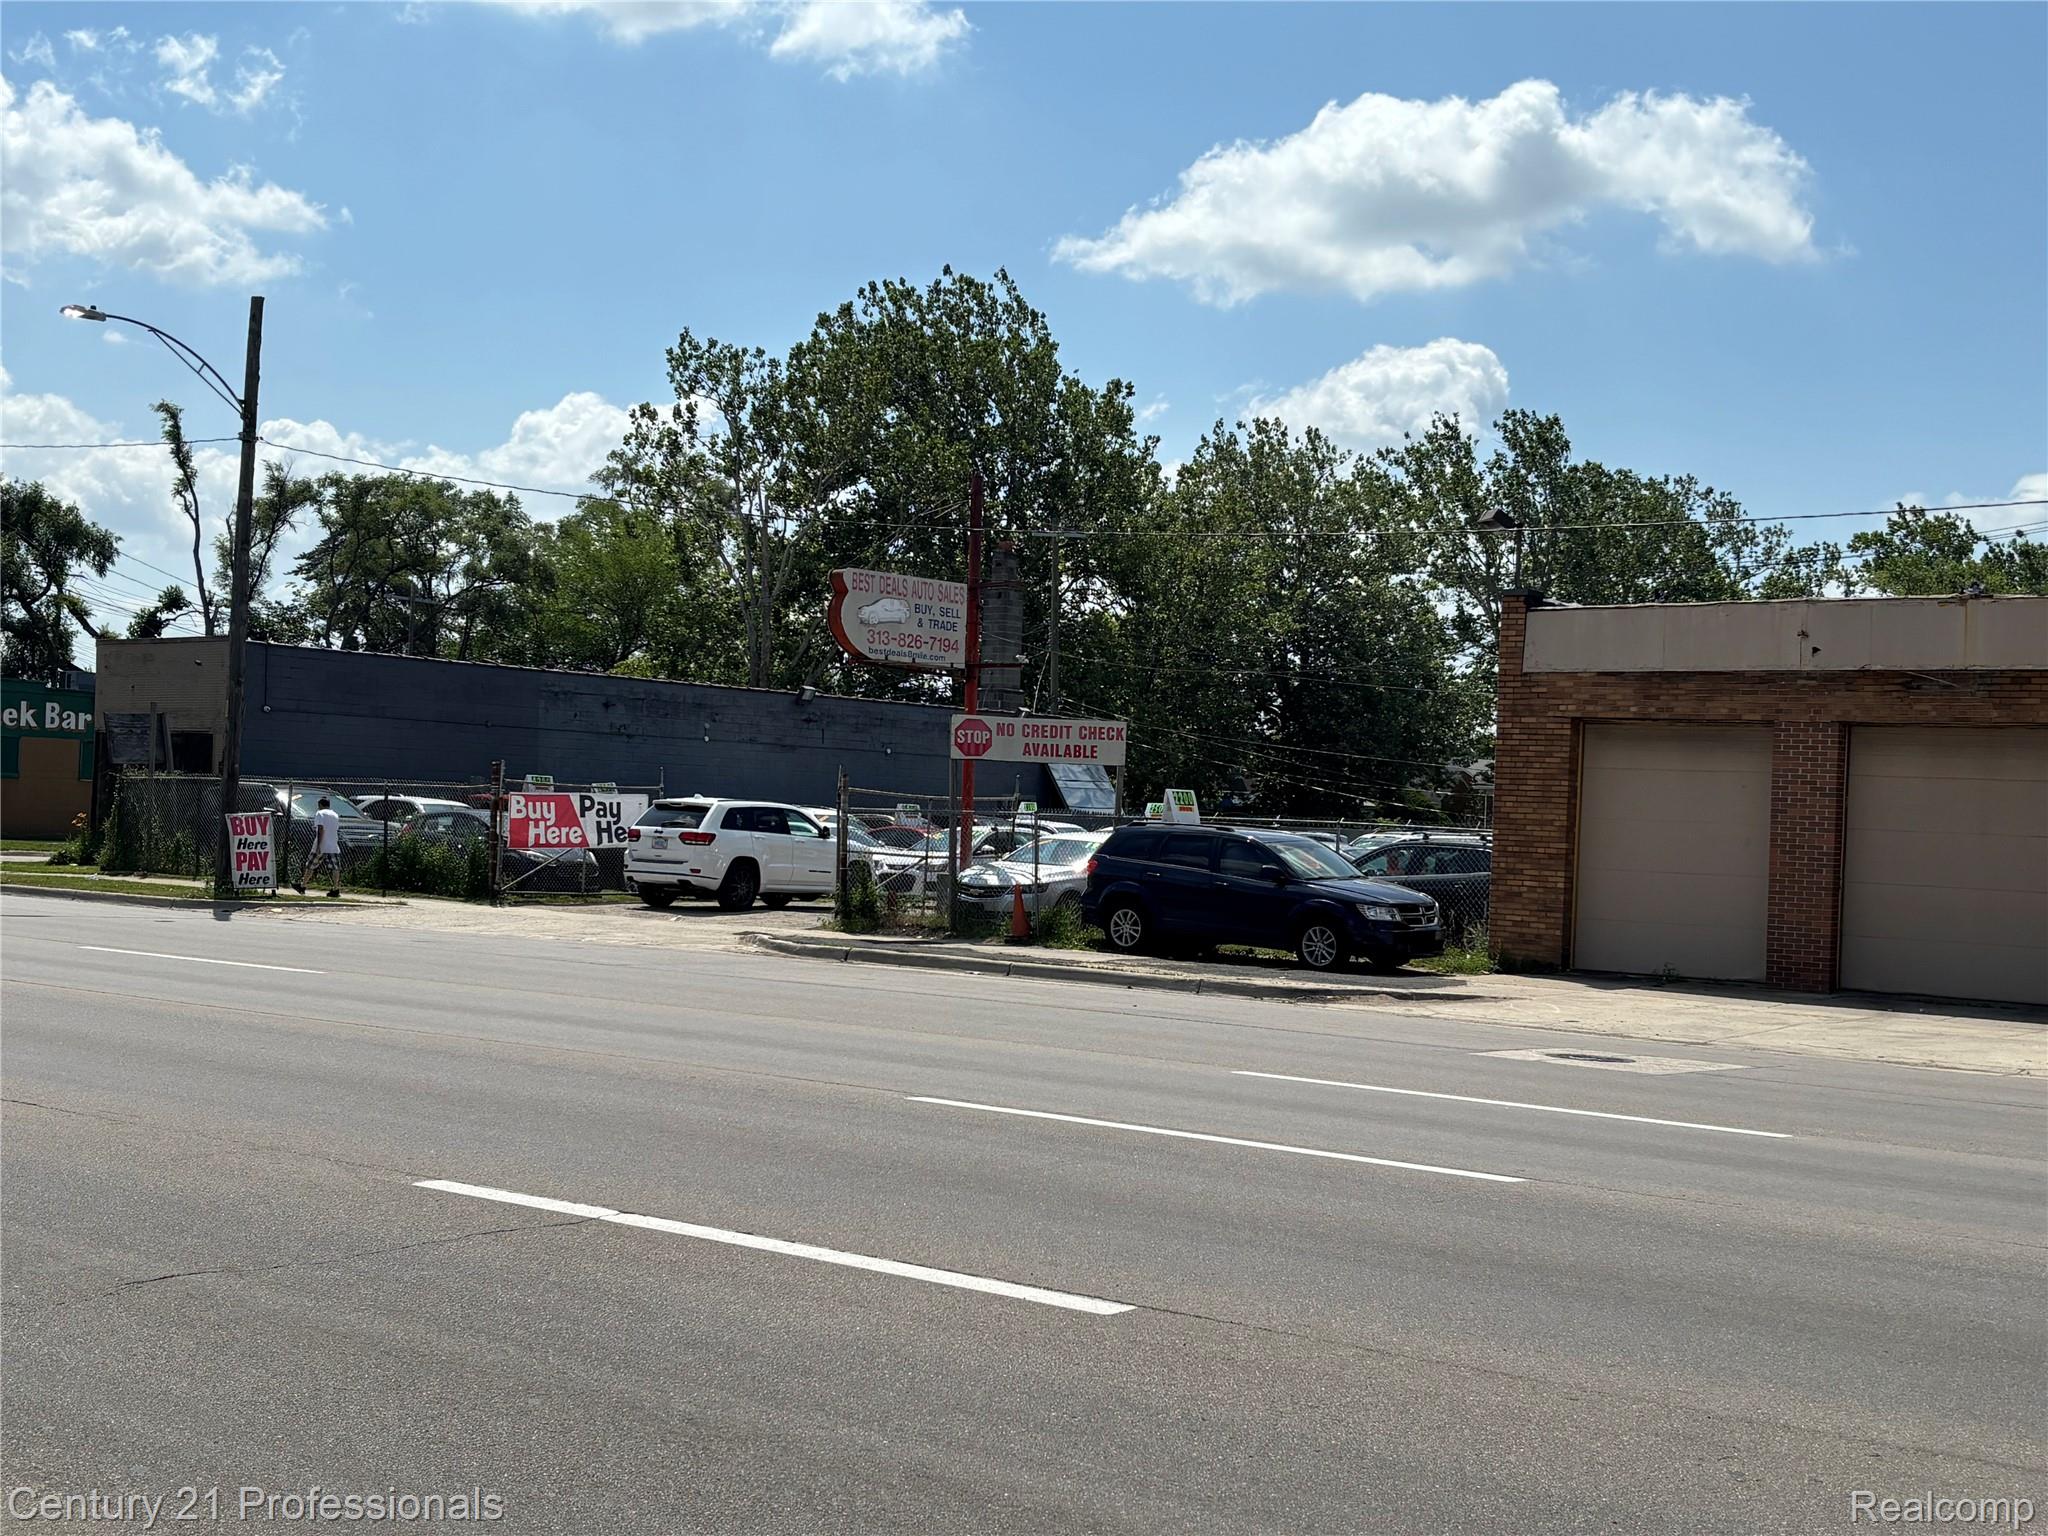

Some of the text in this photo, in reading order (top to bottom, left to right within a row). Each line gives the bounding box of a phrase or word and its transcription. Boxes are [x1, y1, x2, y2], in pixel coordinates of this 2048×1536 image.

[852, 572, 965, 605] BEST DEALS AUTO SALES
[939, 606, 961, 619] SELL
[917, 618, 958, 632] & TRADE
[867, 629, 959, 653] 313-826-7194
[2, 701, 92, 730] ek Bar
[957, 729, 990, 744] STOP
[996, 722, 1124, 741] NO CREDIT CHECK
[1022, 743, 1098, 759] AVAILABLE
[510, 795, 555, 826] Buy
[580, 794, 621, 825] Pay
[230, 816, 270, 836] BUY
[528, 821, 582, 848] Here
[596, 820, 629, 846] He
[237, 838, 267, 850] Here
[236, 851, 270, 871] PAY
[239, 872, 270, 885] Here
